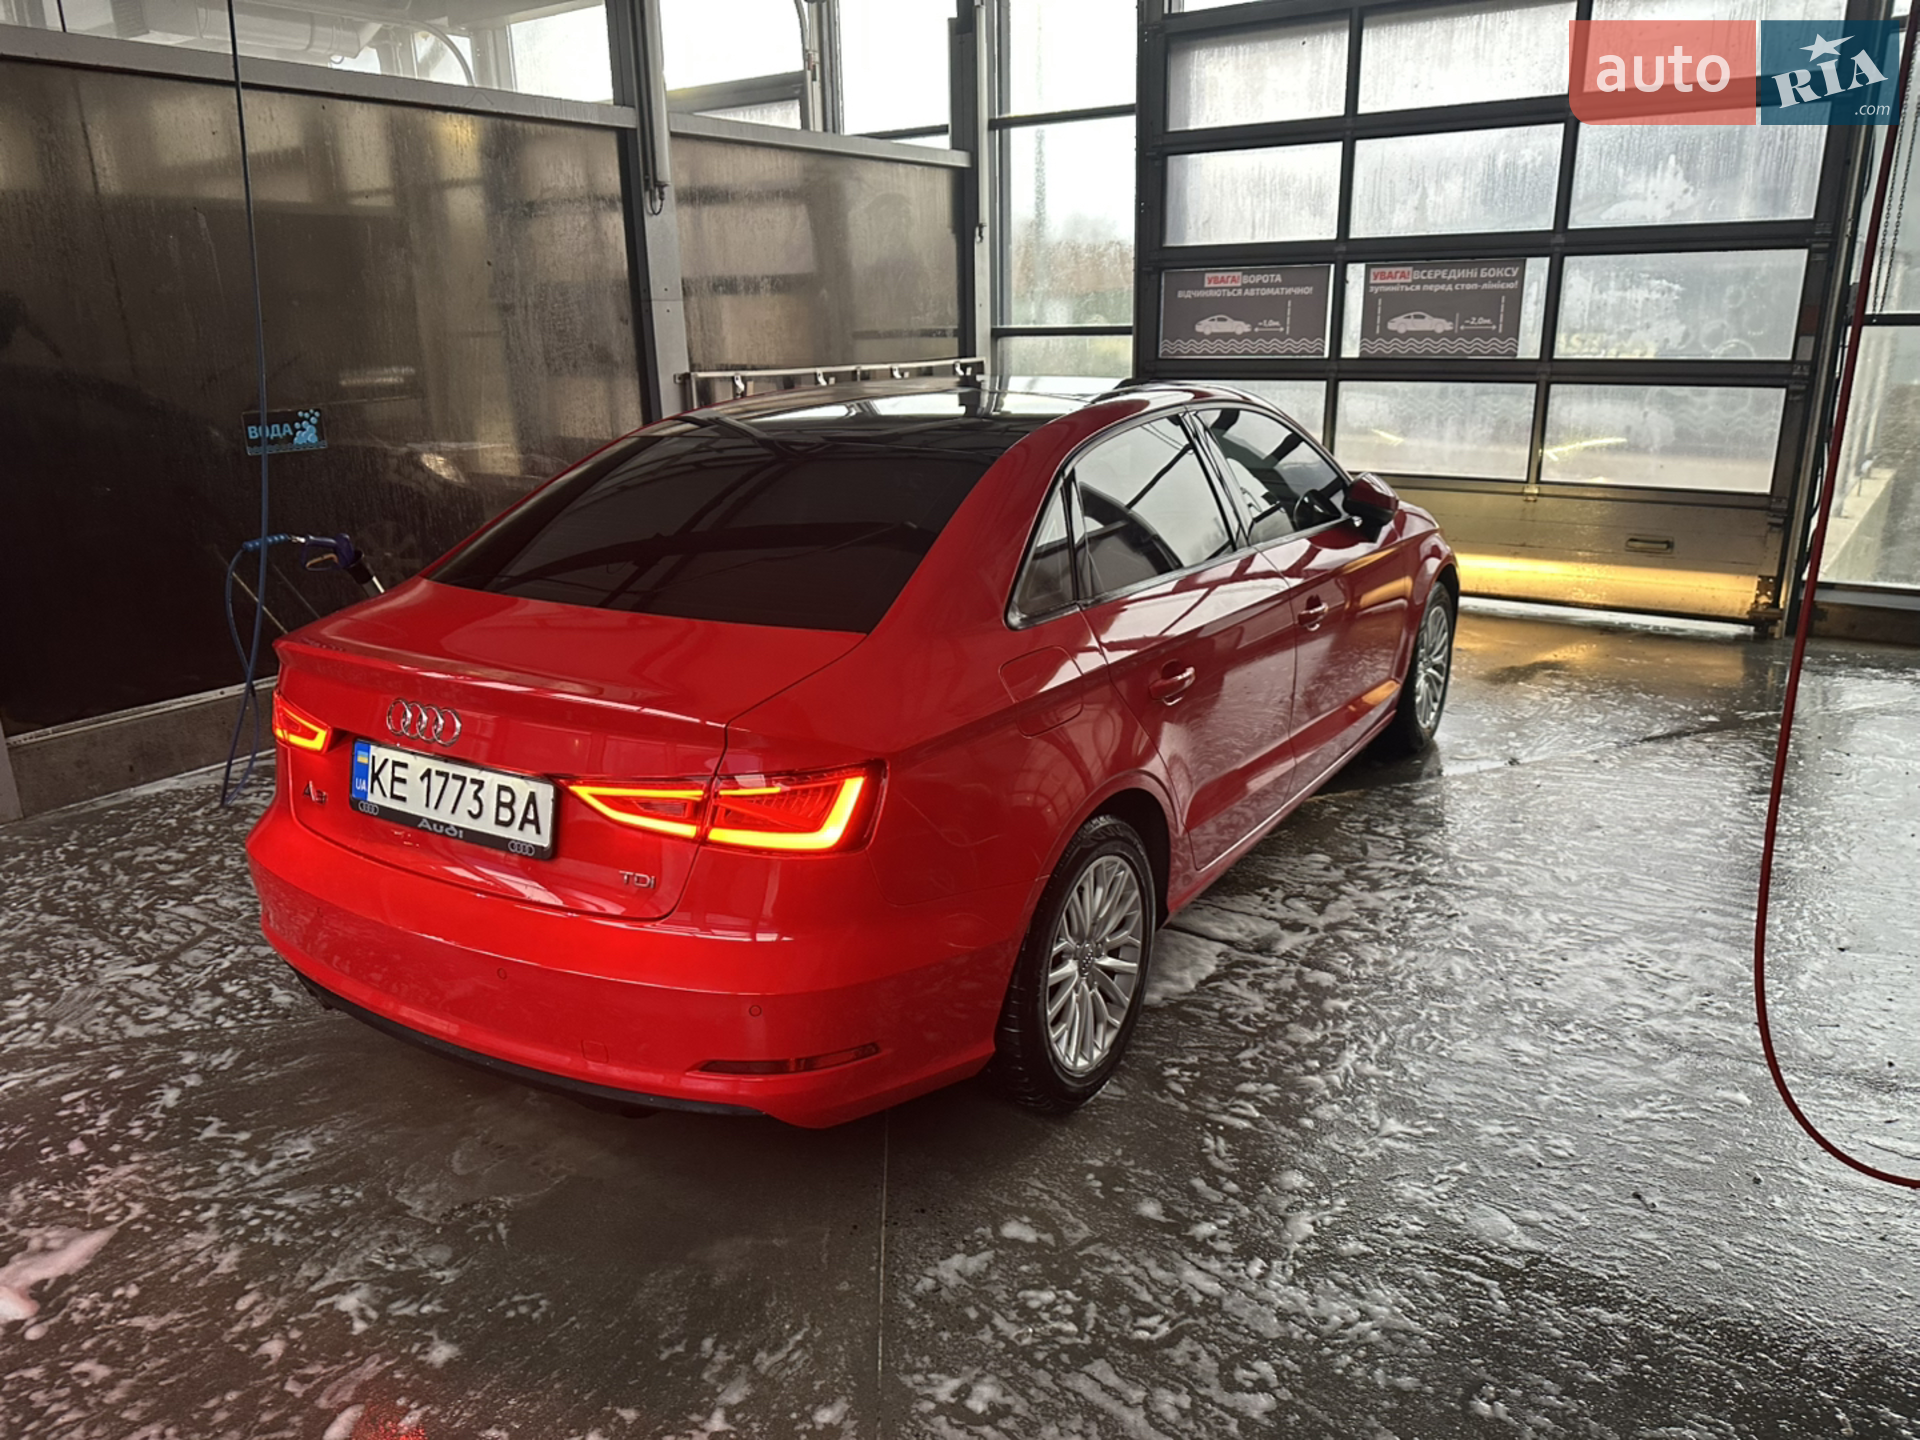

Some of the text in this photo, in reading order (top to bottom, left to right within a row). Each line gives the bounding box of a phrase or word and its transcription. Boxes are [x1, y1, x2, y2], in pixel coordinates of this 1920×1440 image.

[1206, 274, 1282, 286] УВАГА! ВОРОТА
[1372, 270, 1411, 281] УВАГА!
[1480, 266, 1519, 278] БОКСУ
[1177, 286, 1313, 299] ВІДЧИНЯЮТЬСЯ АВТОМАТИЧНО!
[1422, 283, 1453, 293] перед
[355, 777, 367, 792] UA
[370, 754, 542, 835] KE 1773 BA
[417, 818, 464, 839] Audi
[619, 870, 656, 889] TDI
